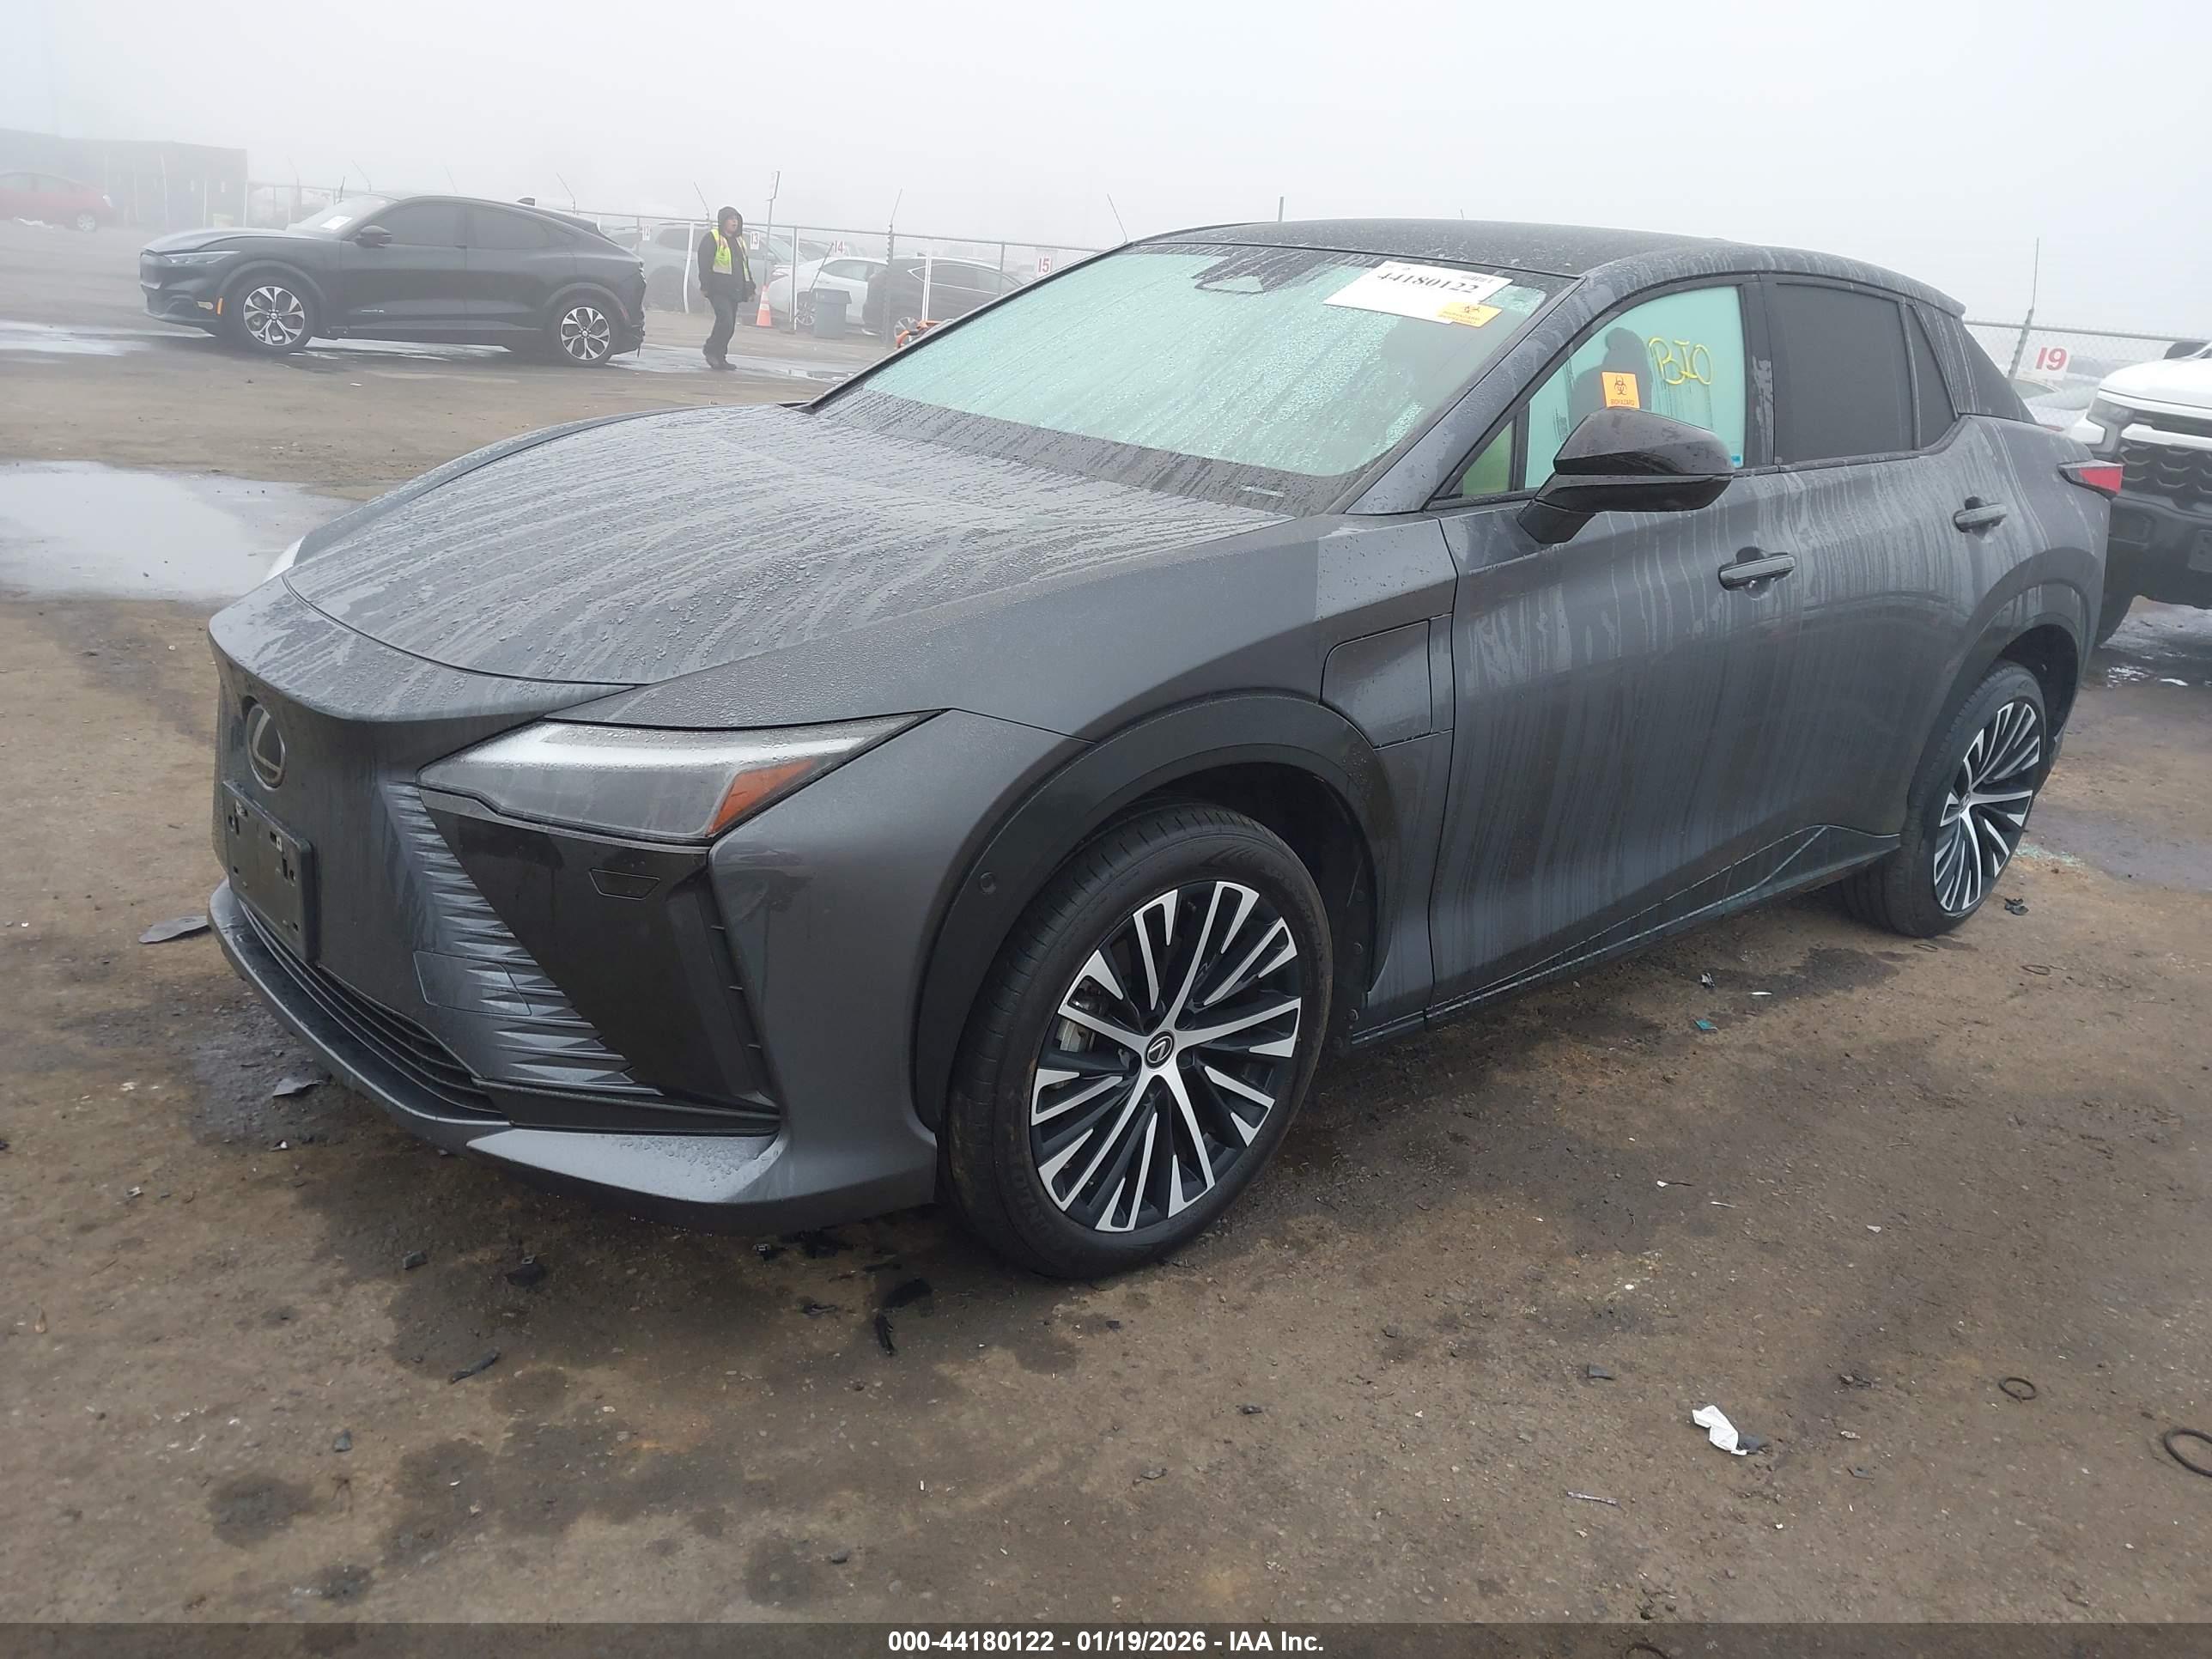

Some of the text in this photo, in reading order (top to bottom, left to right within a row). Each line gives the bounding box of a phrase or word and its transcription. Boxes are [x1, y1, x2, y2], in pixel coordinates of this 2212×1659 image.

[835, 240, 843, 253] 14
[1038, 258, 1049, 272] 15
[1376, 272, 1480, 294] 44180122
[1649, 337, 1713, 385] BIO
[2036, 347, 2067, 371] 19
